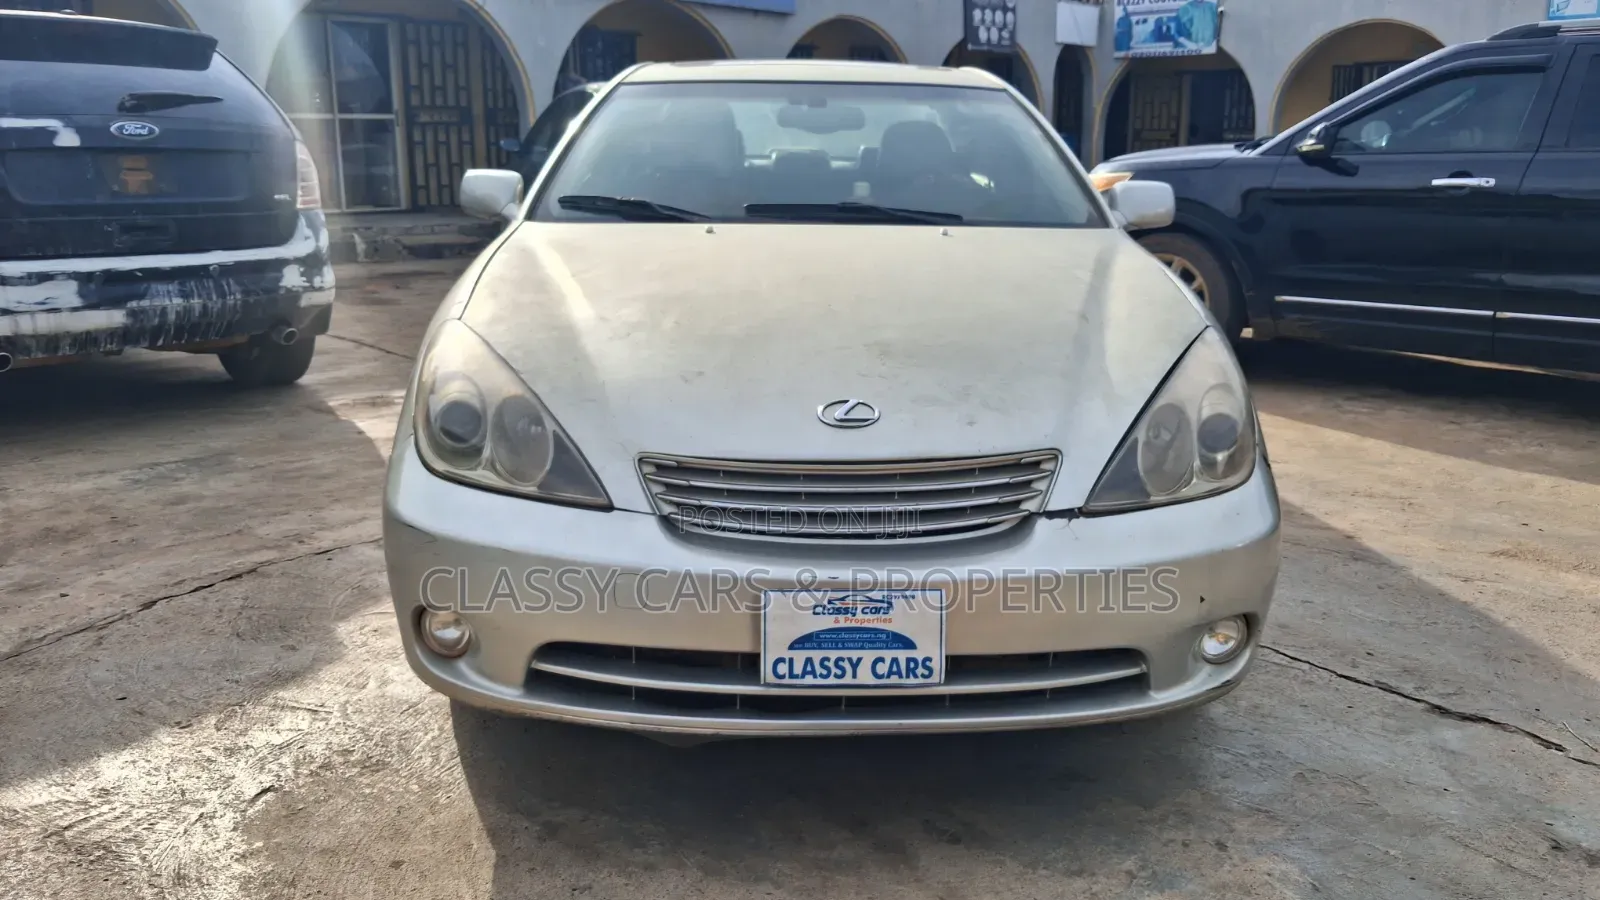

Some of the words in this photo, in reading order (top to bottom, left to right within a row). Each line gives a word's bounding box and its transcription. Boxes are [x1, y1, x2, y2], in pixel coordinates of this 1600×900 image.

[122, 124, 149, 135] Ford
[812, 604, 858, 617] Classy
[861, 604, 892, 615] cars
[844, 616, 893, 625] Properties
[772, 656, 863, 680] CLASSY
[871, 656, 934, 680] CARS
